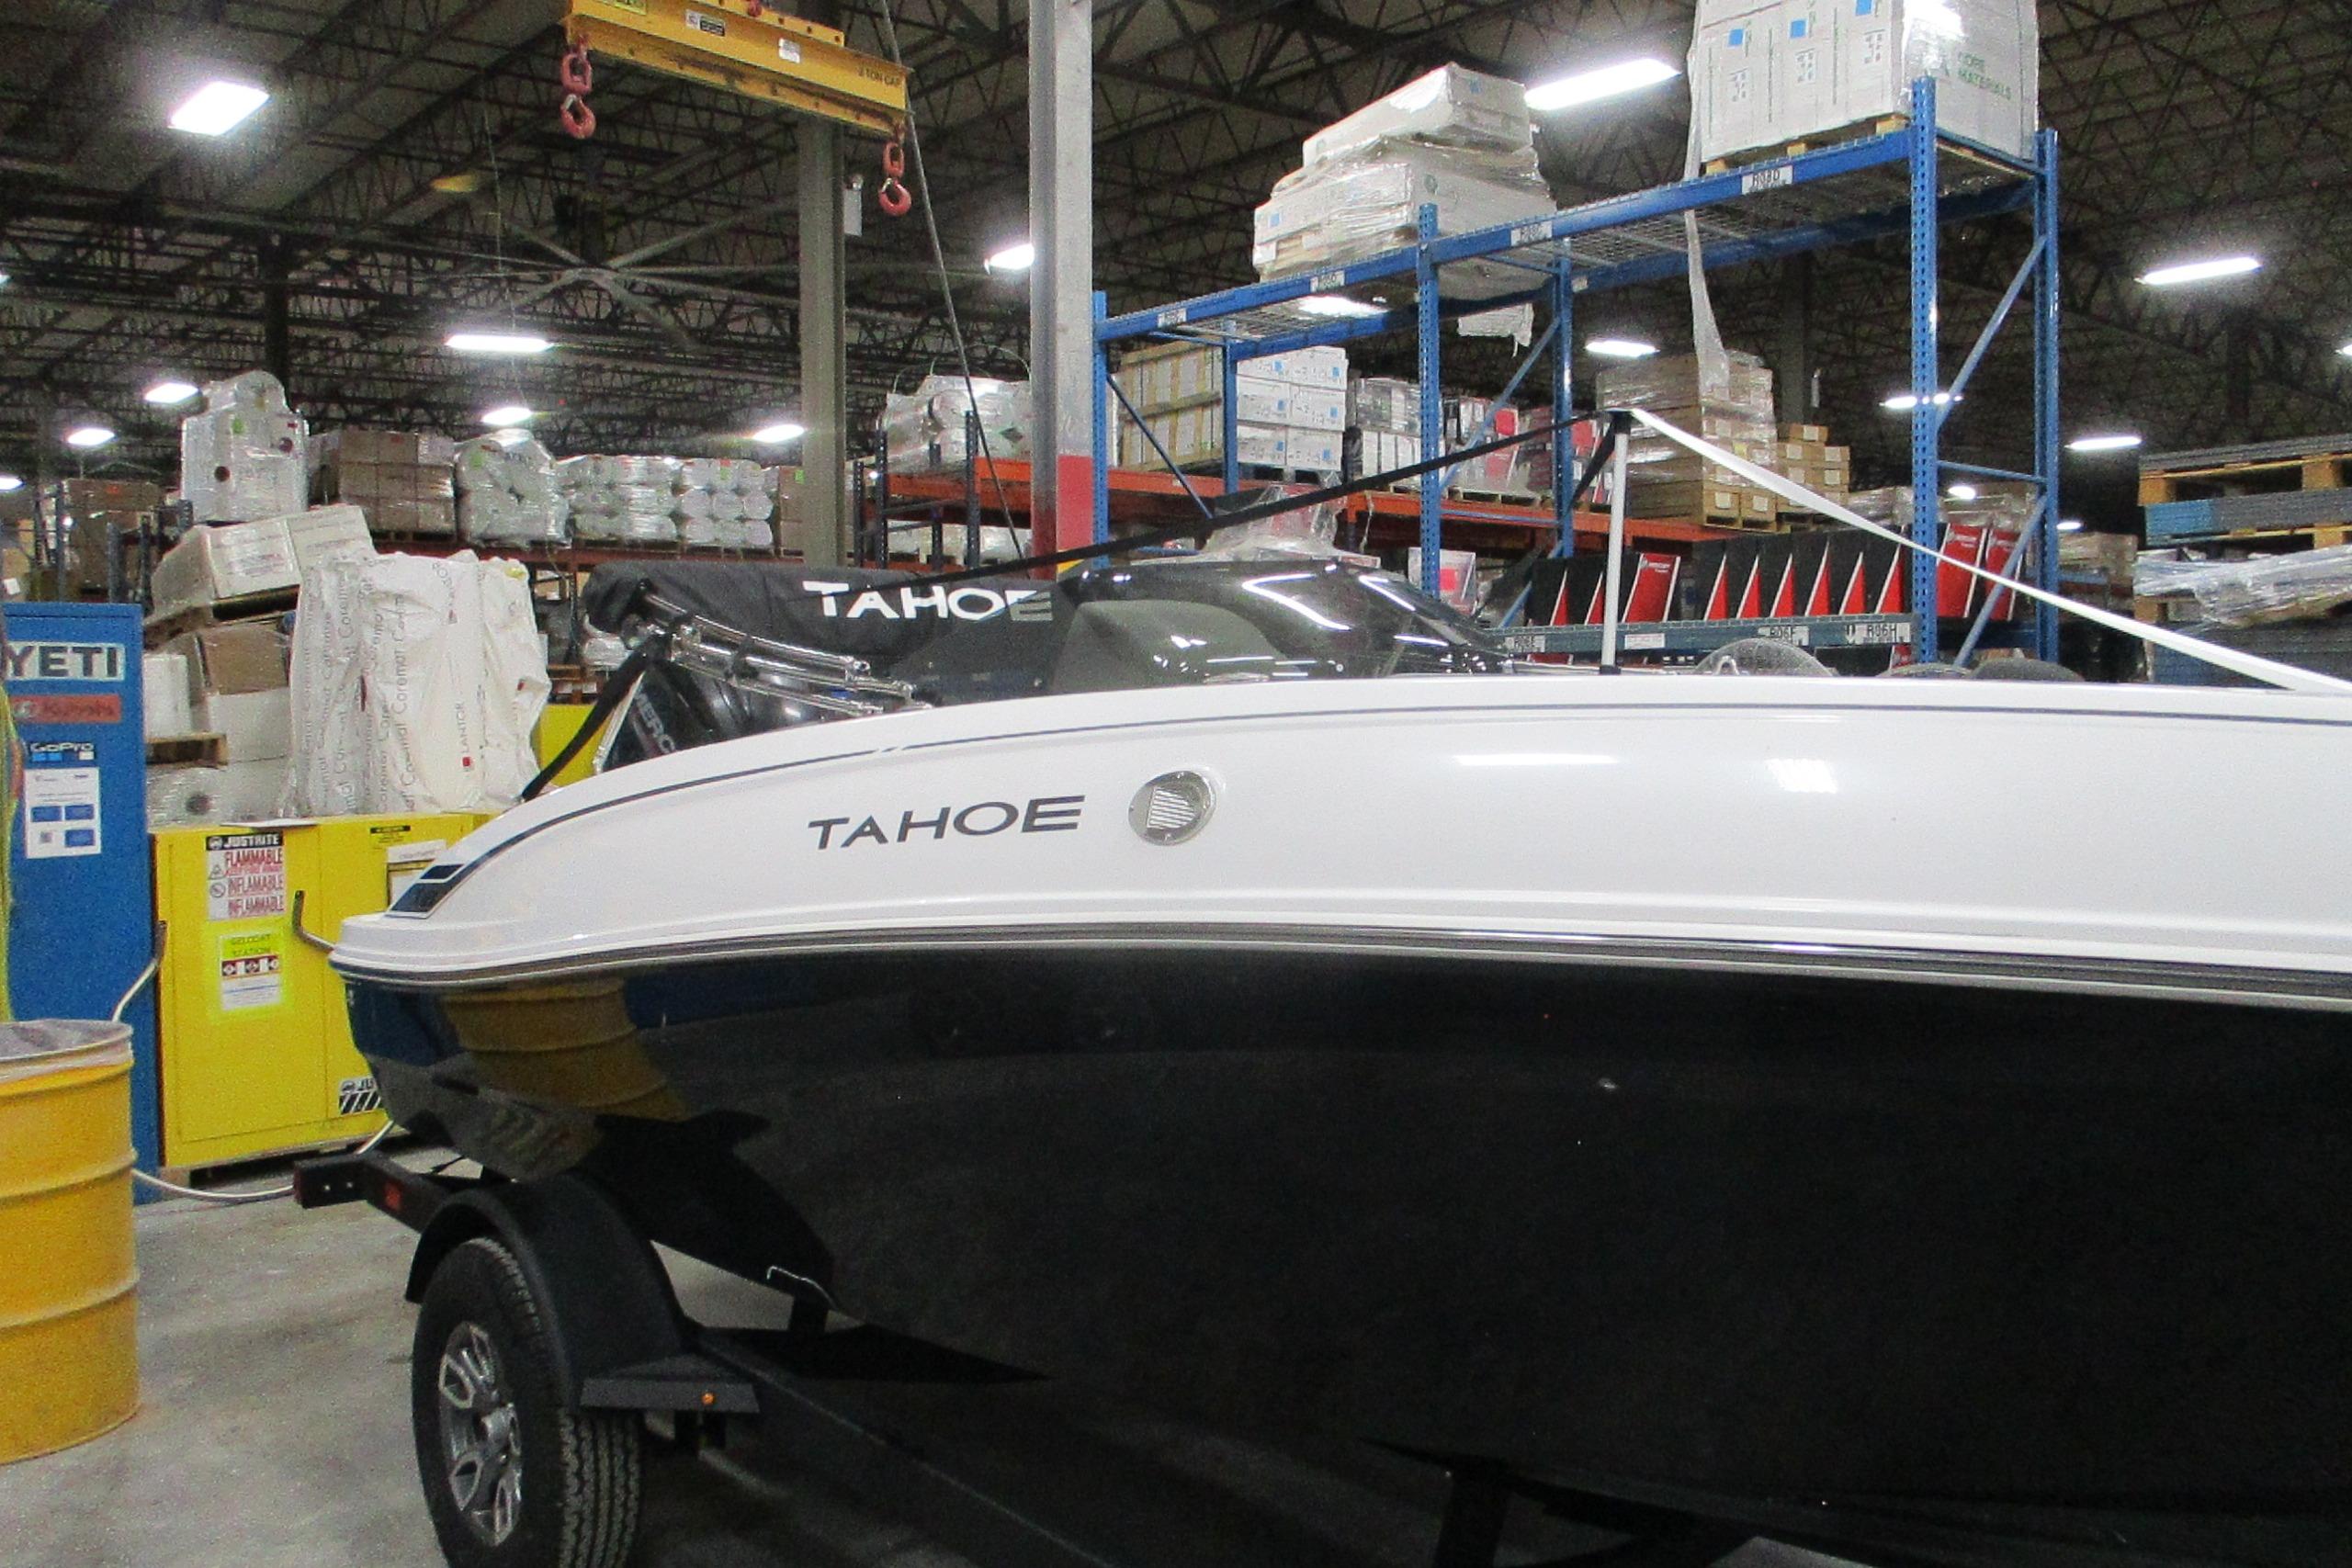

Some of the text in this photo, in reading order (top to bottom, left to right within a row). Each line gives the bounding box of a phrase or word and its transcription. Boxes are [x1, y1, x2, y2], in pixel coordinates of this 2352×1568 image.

[802, 581, 1053, 621] TAHOE
[4, 646, 118, 677] YETI
[391, 649, 407, 715] Coremat
[30, 742, 94, 752] GoPro
[808, 795, 1086, 850] TAHOE
[226, 848, 283, 868] FLAMMABLE
